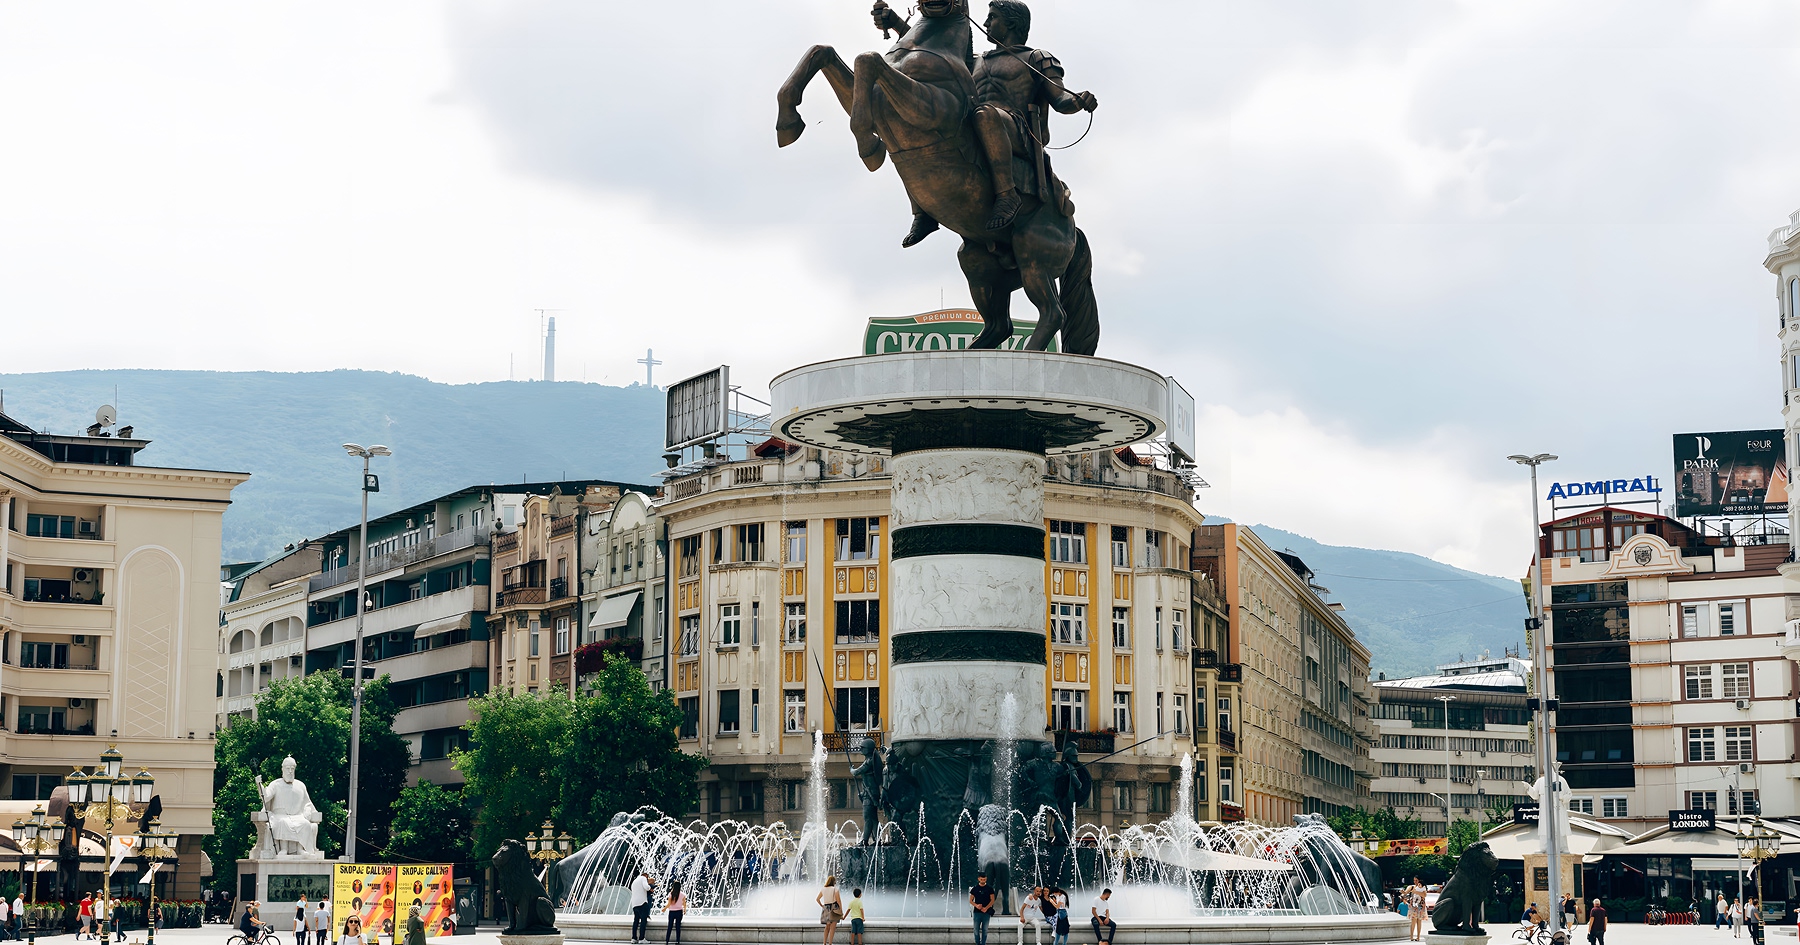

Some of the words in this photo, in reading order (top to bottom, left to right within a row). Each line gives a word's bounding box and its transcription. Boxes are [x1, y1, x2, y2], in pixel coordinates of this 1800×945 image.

[922, 313, 962, 322] PREMIUM
[965, 313, 983, 321] QUA
[1747, 439, 1772, 449] FOUR
[1683, 458, 1719, 469] PARK
[1546, 475, 1663, 500] ADMIRAL
[1580, 515, 1603, 525] HOTEL
[1672, 820, 1710, 828] LONDON
[340, 865, 365, 875] SKOPJE
[365, 866, 392, 875] CALLING
[402, 866, 425, 876] SKOPJE
[425, 866, 449, 876] CALLING
